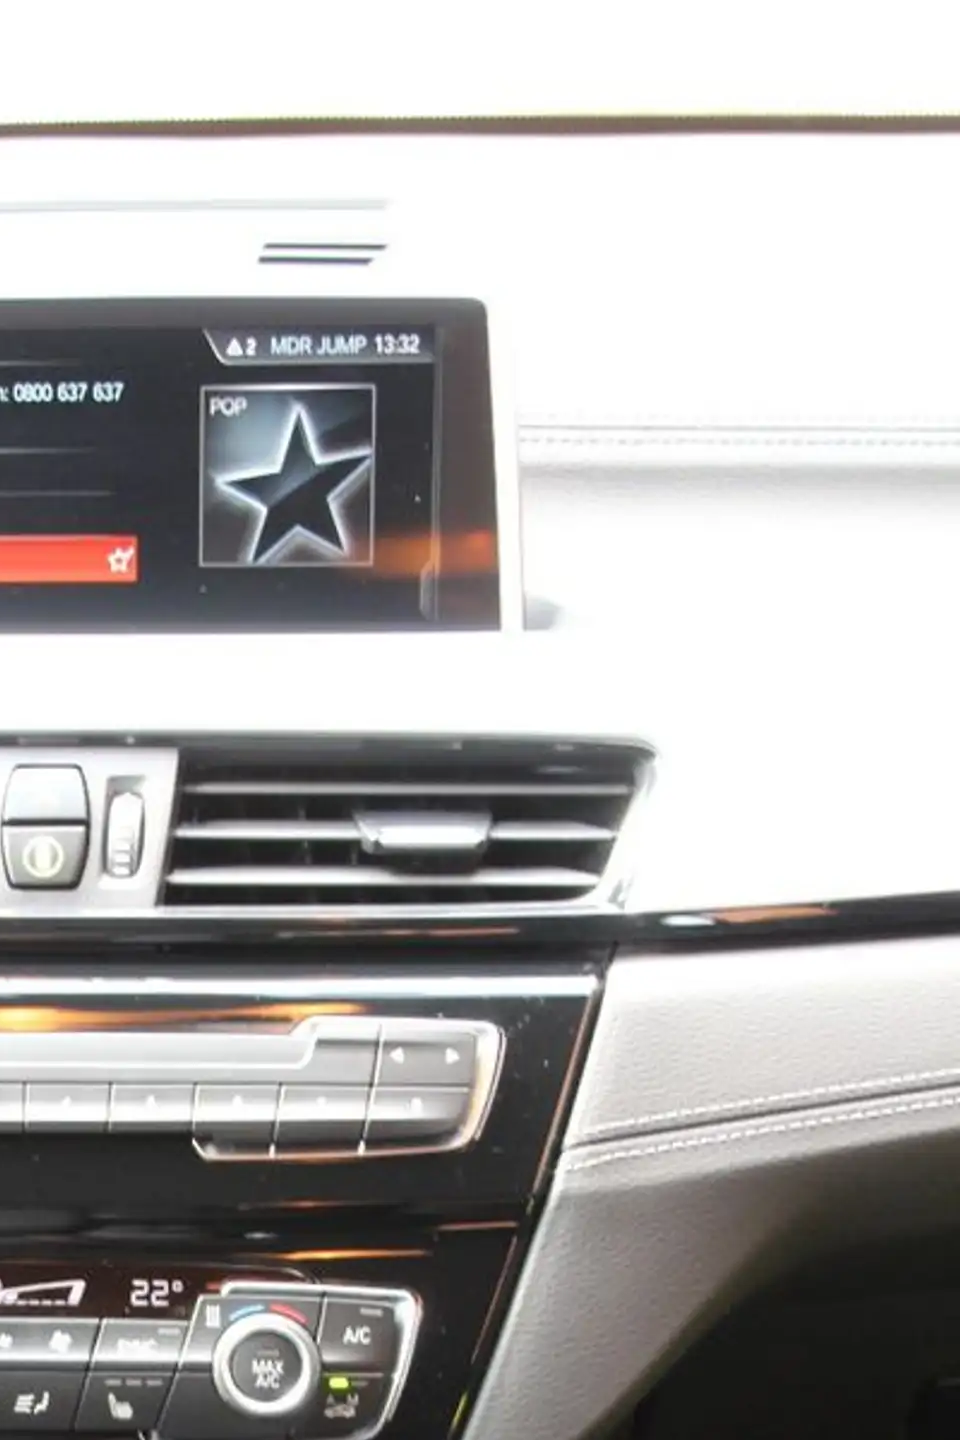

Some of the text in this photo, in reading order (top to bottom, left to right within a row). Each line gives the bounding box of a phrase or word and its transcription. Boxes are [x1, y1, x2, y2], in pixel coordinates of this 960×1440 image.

[245, 333, 420, 357] 2 MDR JUMP 13:32
[13, 381, 52, 403] 0800
[57, 380, 87, 402] 637
[92, 380, 124, 402] 637
[209, 396, 248, 417] POP
[342, 1325, 372, 1345] A/C
[251, 1358, 285, 1375] MAX
[254, 1373, 281, 1390] A/C
